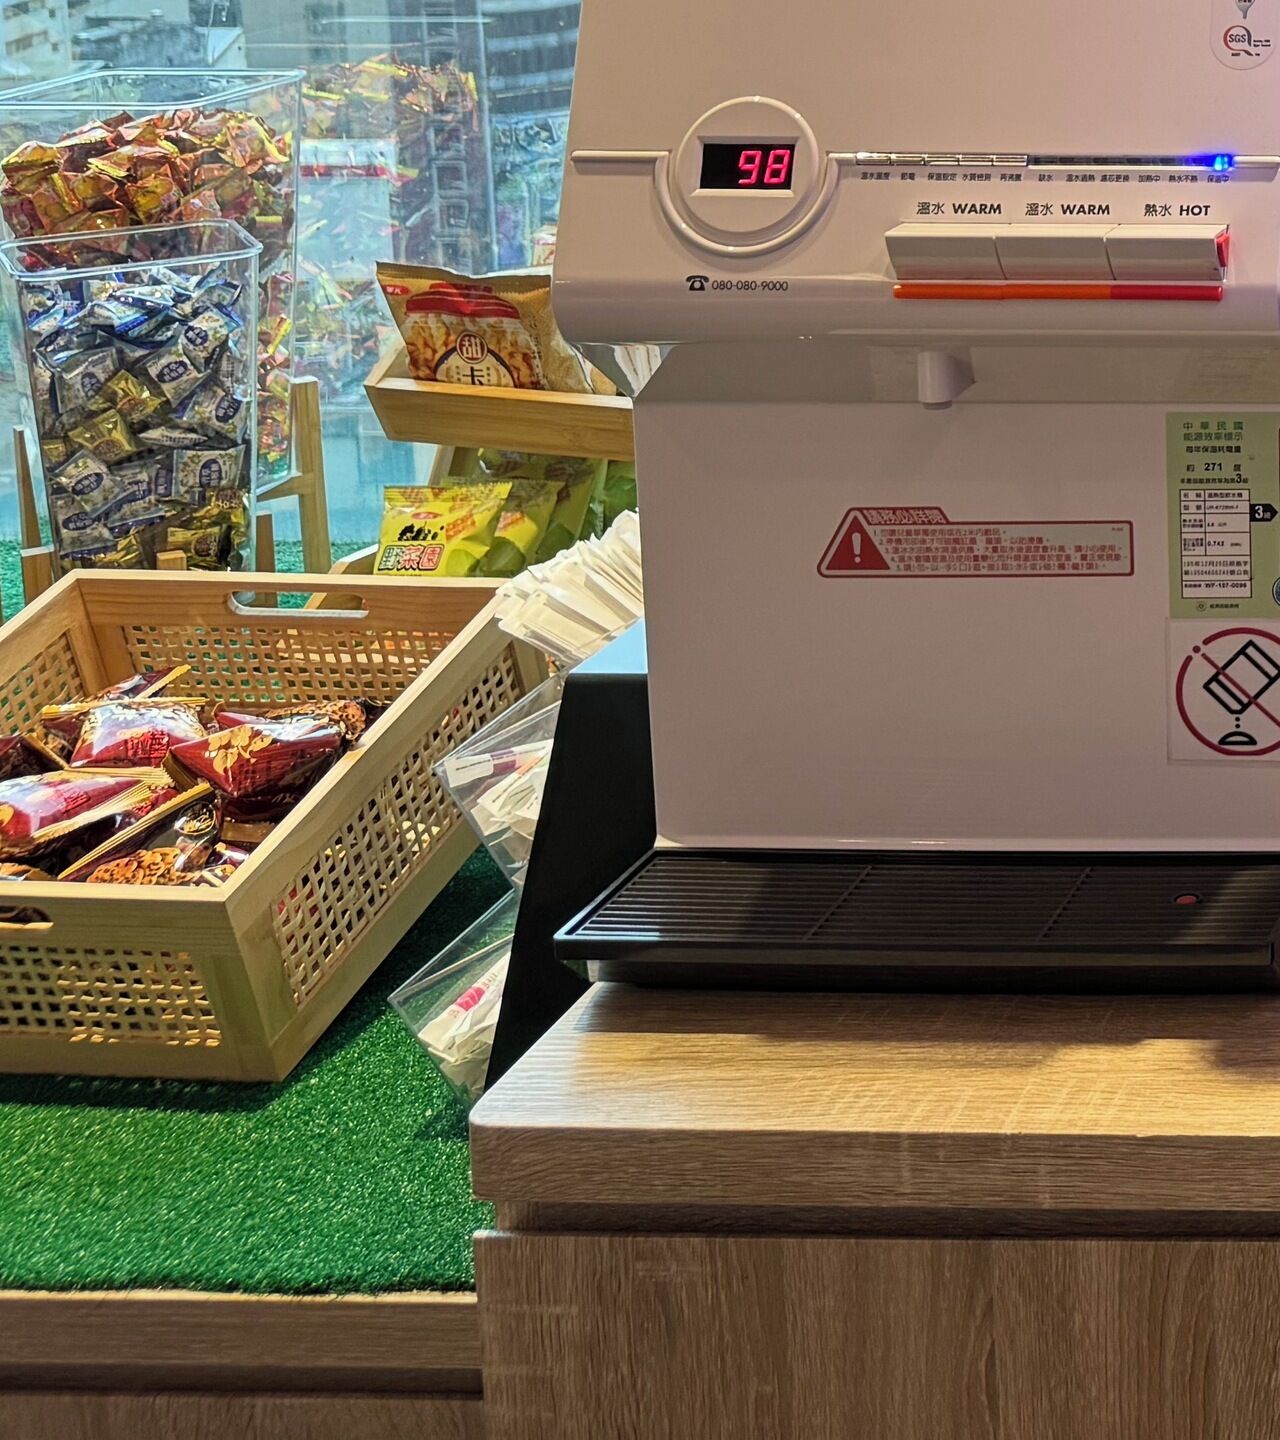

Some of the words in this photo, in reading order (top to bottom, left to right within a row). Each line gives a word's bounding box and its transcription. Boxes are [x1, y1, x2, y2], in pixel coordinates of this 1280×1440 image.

[1229, 33, 1246, 43] SGS
[738, 150, 791, 184] 98
[1138, 174, 1160, 183] 加熱中
[917, 202, 944, 215] 溫水
[952, 203, 1002, 215] WARM
[1025, 203, 1053, 216] 溫水
[1061, 204, 1110, 216] WARM
[1144, 204, 1171, 217] 熱水
[1179, 205, 1211, 217] HOT
[712, 280, 788, 291] 080-080-9000
[461, 336, 482, 358] 甜
[1204, 462, 1223, 472] 271
[378, 544, 444, 572] 野菜園
